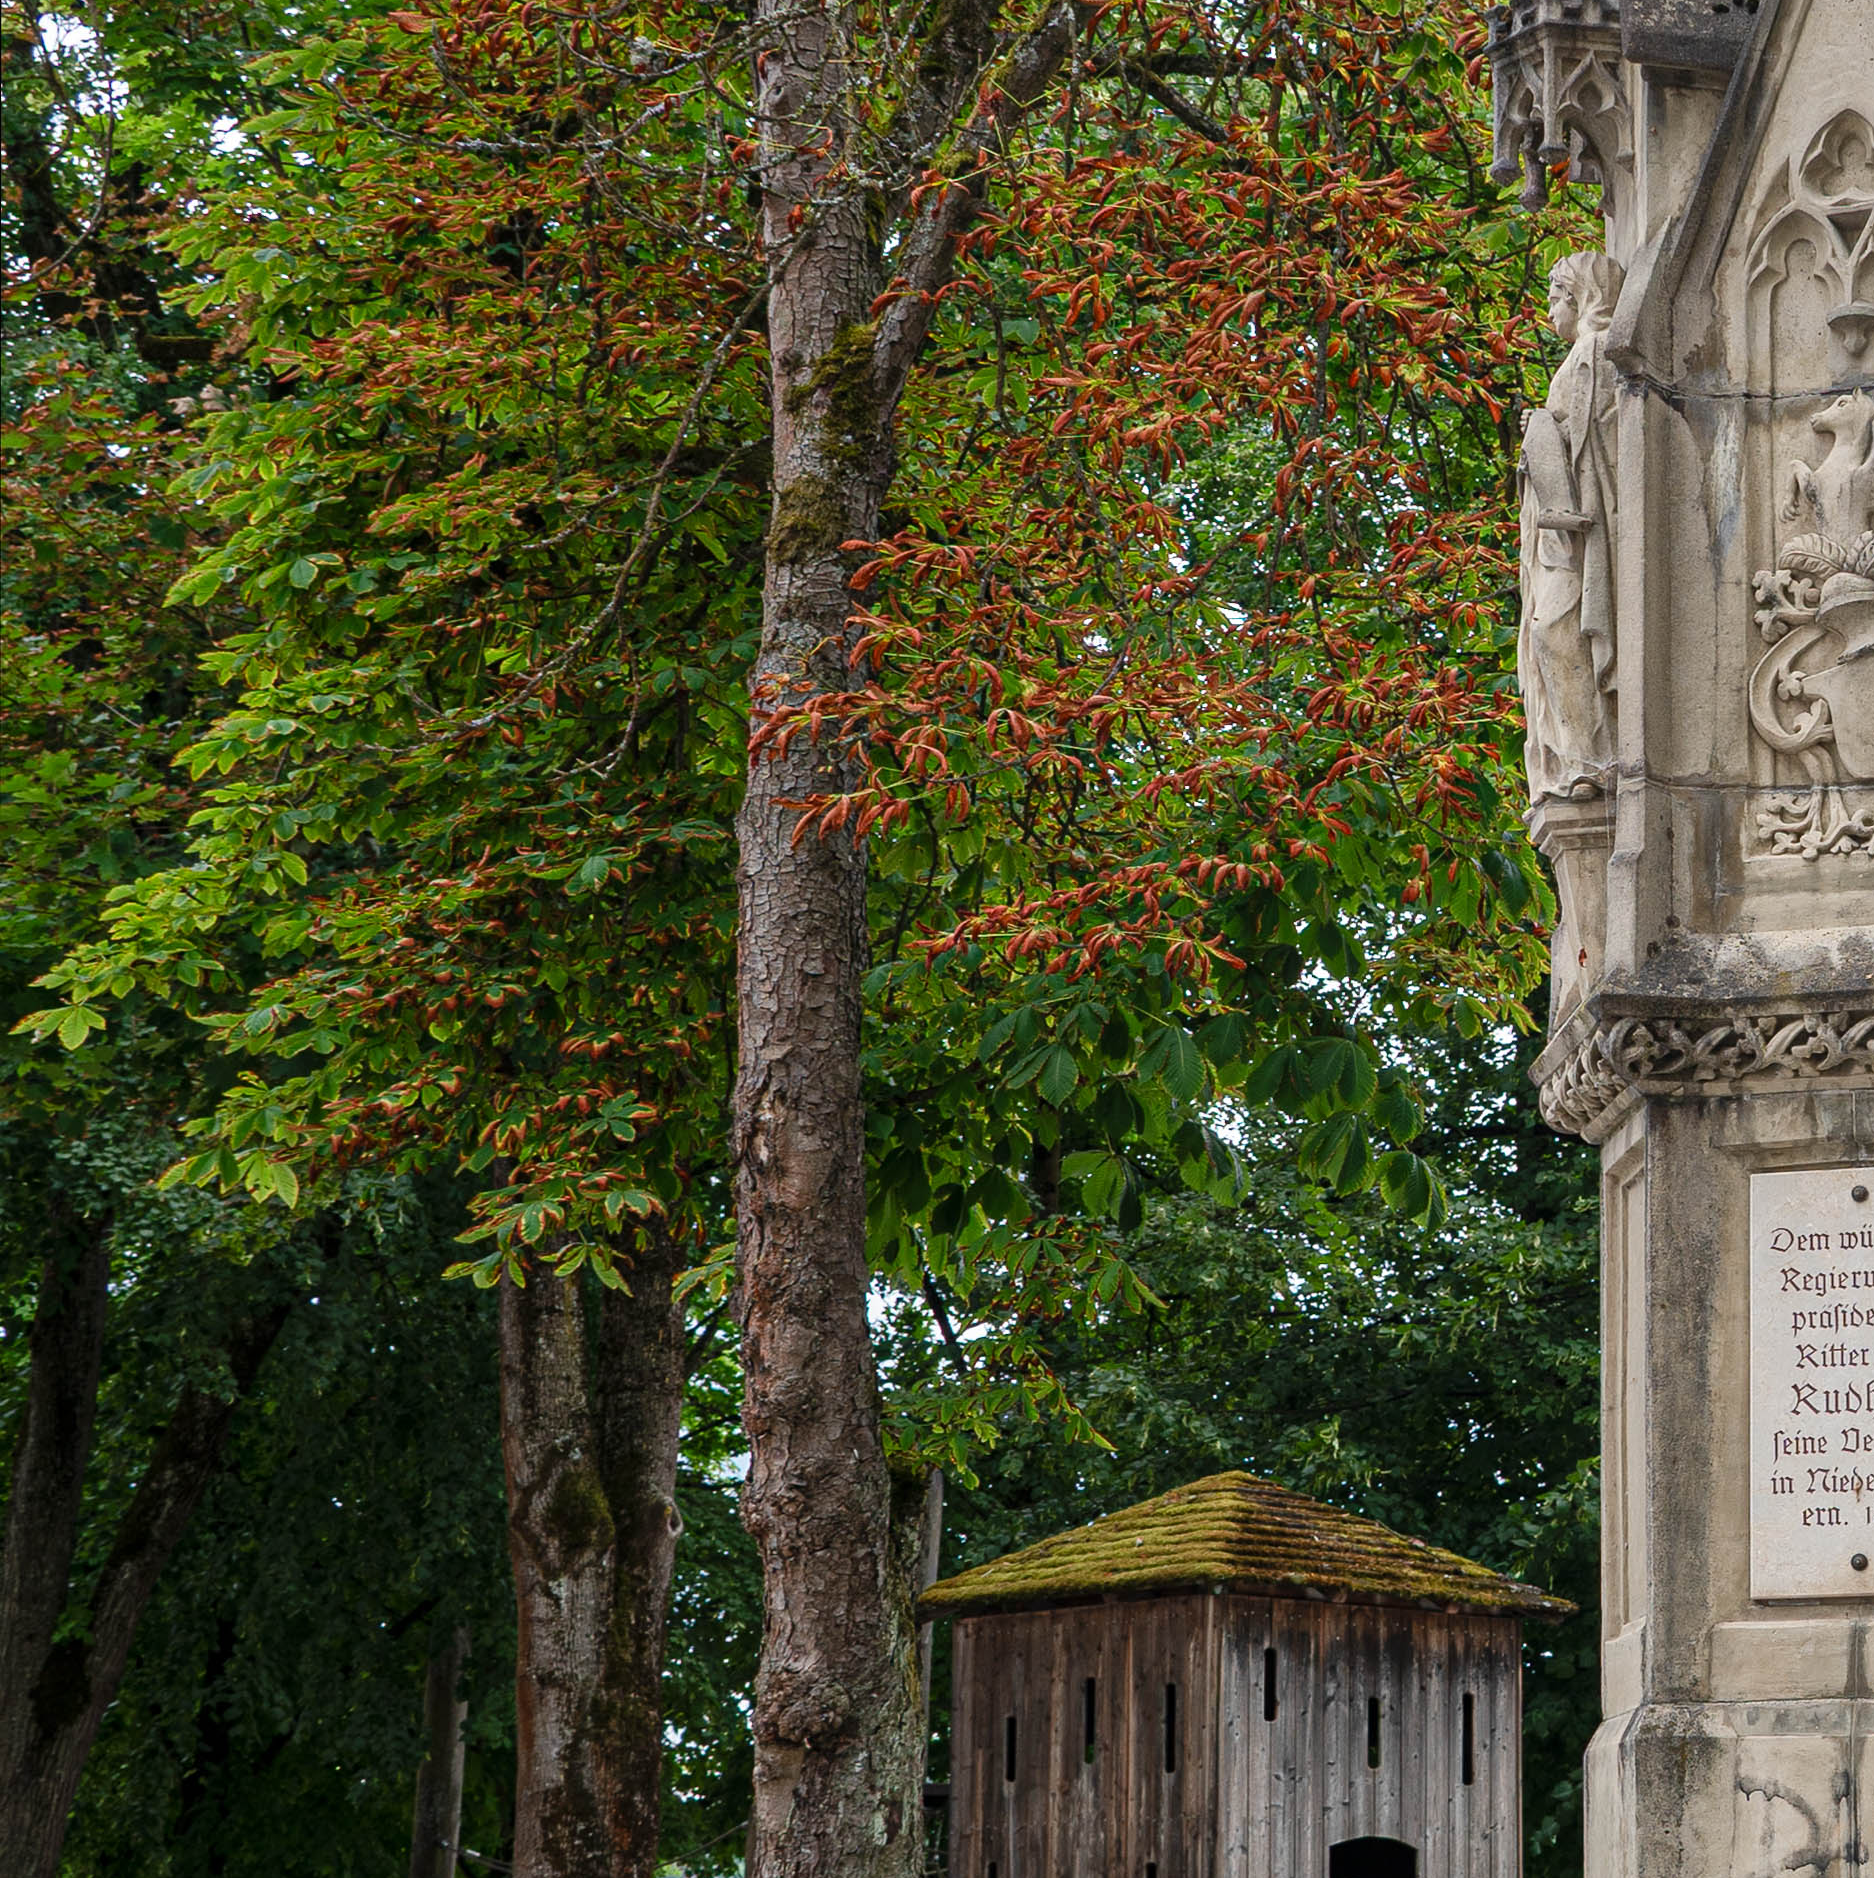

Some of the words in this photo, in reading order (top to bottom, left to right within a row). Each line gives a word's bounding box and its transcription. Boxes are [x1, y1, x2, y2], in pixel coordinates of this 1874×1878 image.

[1770, 1228, 1830, 1252] Dem
[1796, 1343, 1869, 1369] Ritter
[1771, 1470, 1794, 1494] in
[1803, 1507, 1848, 1526] ern.
